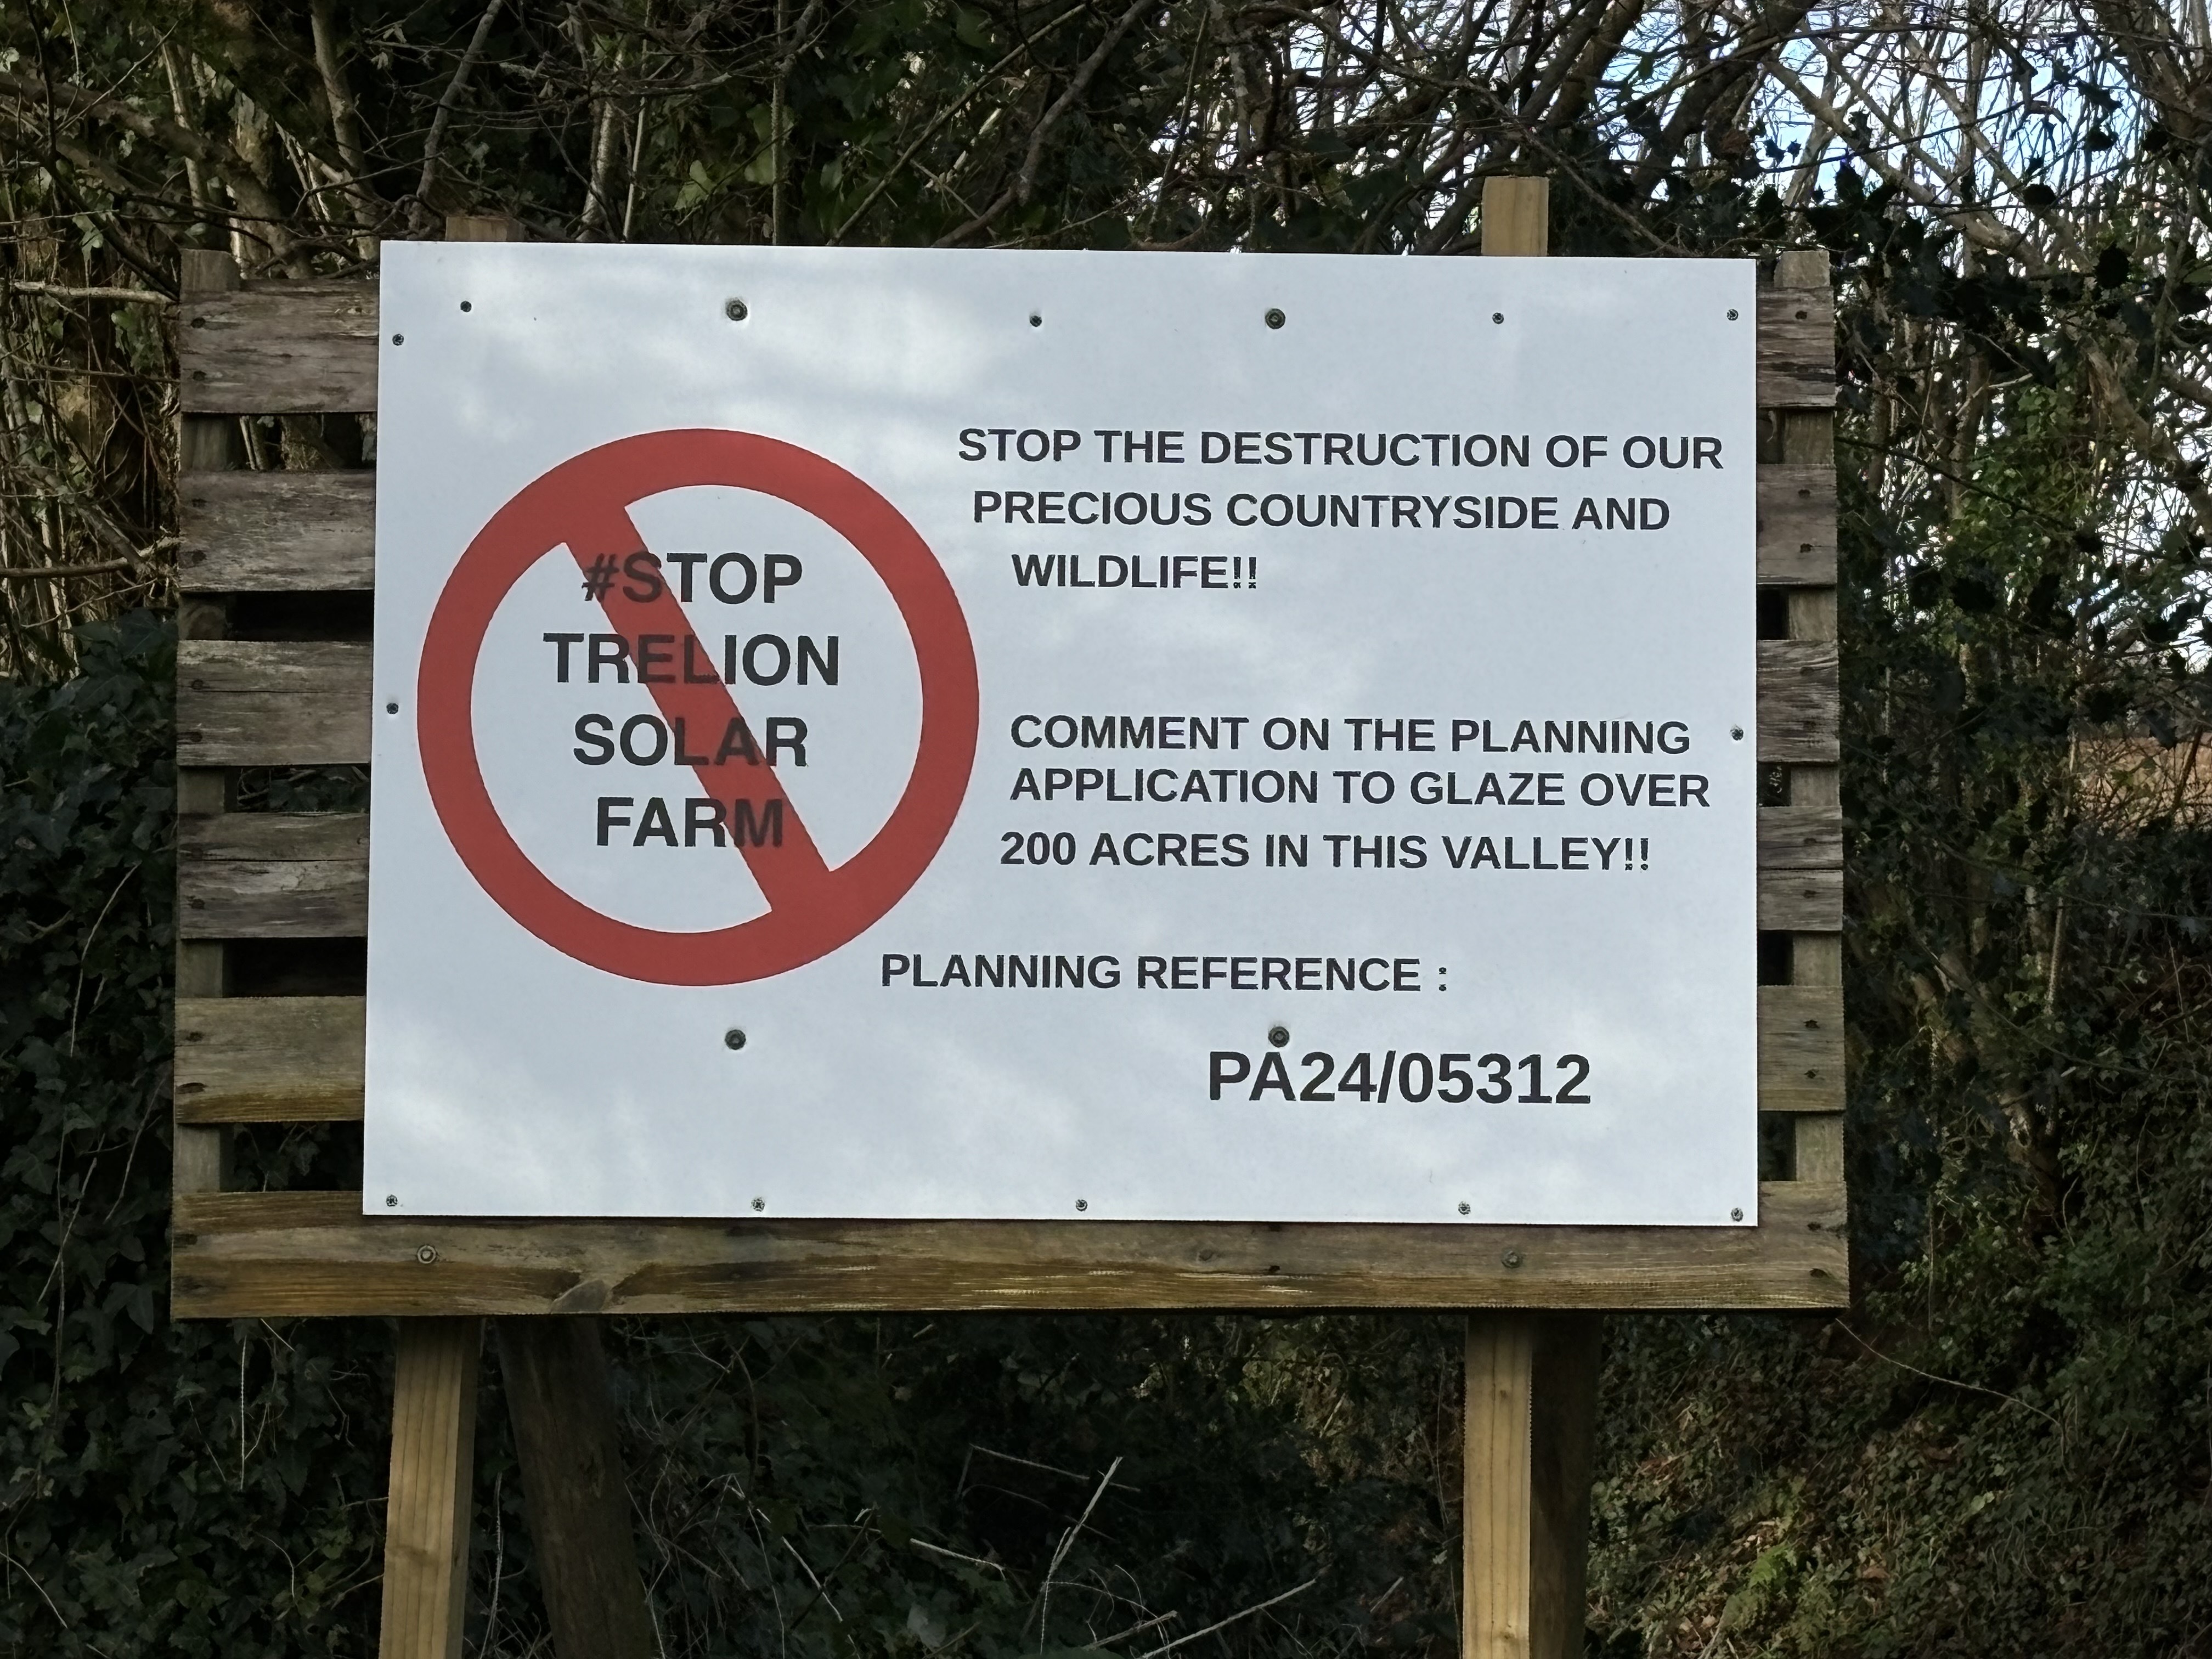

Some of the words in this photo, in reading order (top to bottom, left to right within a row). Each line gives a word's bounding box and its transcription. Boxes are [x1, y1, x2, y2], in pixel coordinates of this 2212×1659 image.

[959, 428, 1081, 462] STOP
[1093, 430, 1184, 464] THE
[1201, 431, 1529, 467] DESTRUCTION
[1546, 435, 1607, 468] OF
[1623, 436, 1724, 469] OUR
[974, 490, 1211, 526] PRECIOUS
[1227, 493, 1559, 529] COUNTRYSIDE
[1572, 497, 1669, 530] AND
[580, 552, 803, 605] #STOP
[1011, 554, 1256, 589] WILDLIFE!!
[543, 632, 839, 686] TRELION
[573, 713, 808, 767] SOLAR
[1011, 714, 1249, 749] COMMENT
[1263, 717, 1329, 751] ON
[1344, 718, 1436, 752] THE
[1452, 719, 1690, 754] PLANNING
[1010, 768, 1317, 803] APPLICATION
[1333, 771, 1395, 804] TO
[1410, 771, 1565, 805] GLAZE
[1581, 773, 1710, 807] OVER
[597, 796, 783, 849] FARM
[1001, 832, 1076, 865] 200
[1089, 833, 1249, 867] ACRES
[1266, 834, 1308, 867] IN
[1323, 834, 1427, 868] THIS
[1441, 836, 1649, 871] VALLEY!!
[882, 954, 1120, 989] PLANNING
[1138, 956, 1421, 991] REFERENCE
[1210, 1050, 1591, 1104] PA24/05312
